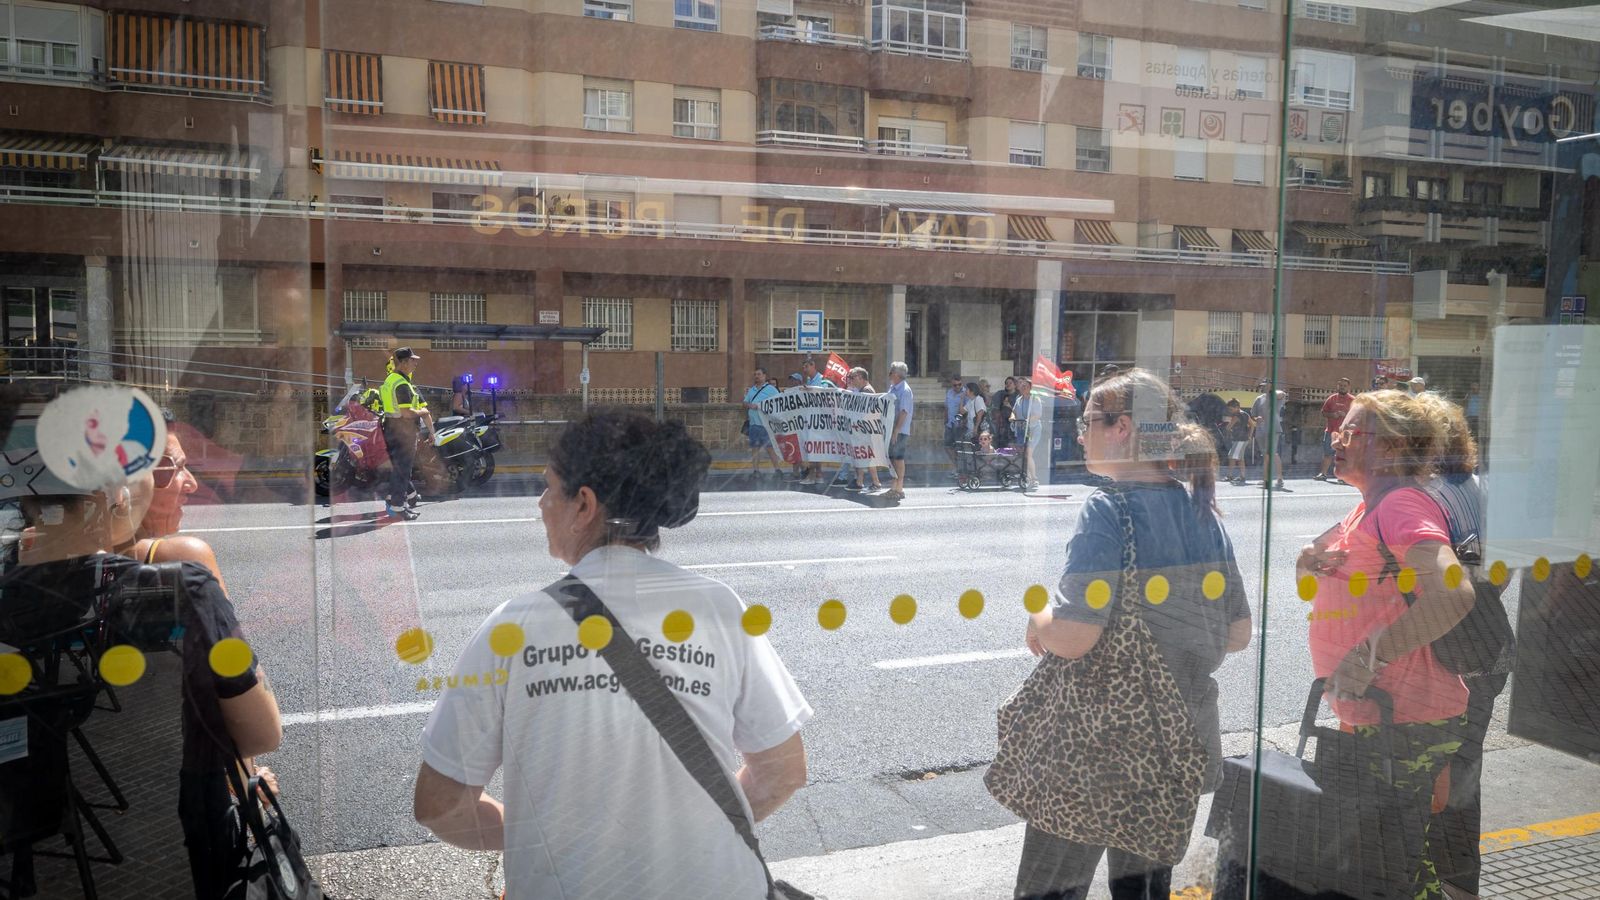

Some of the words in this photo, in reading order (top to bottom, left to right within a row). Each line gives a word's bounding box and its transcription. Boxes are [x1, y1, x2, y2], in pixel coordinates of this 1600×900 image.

[760, 400, 774, 415] LOS
[774, 391, 835, 414] TRABAJADORES
[523, 644, 588, 667] Grupo
[636, 638, 715, 668] Gestión
[525, 669, 711, 698] www.acgon.es
